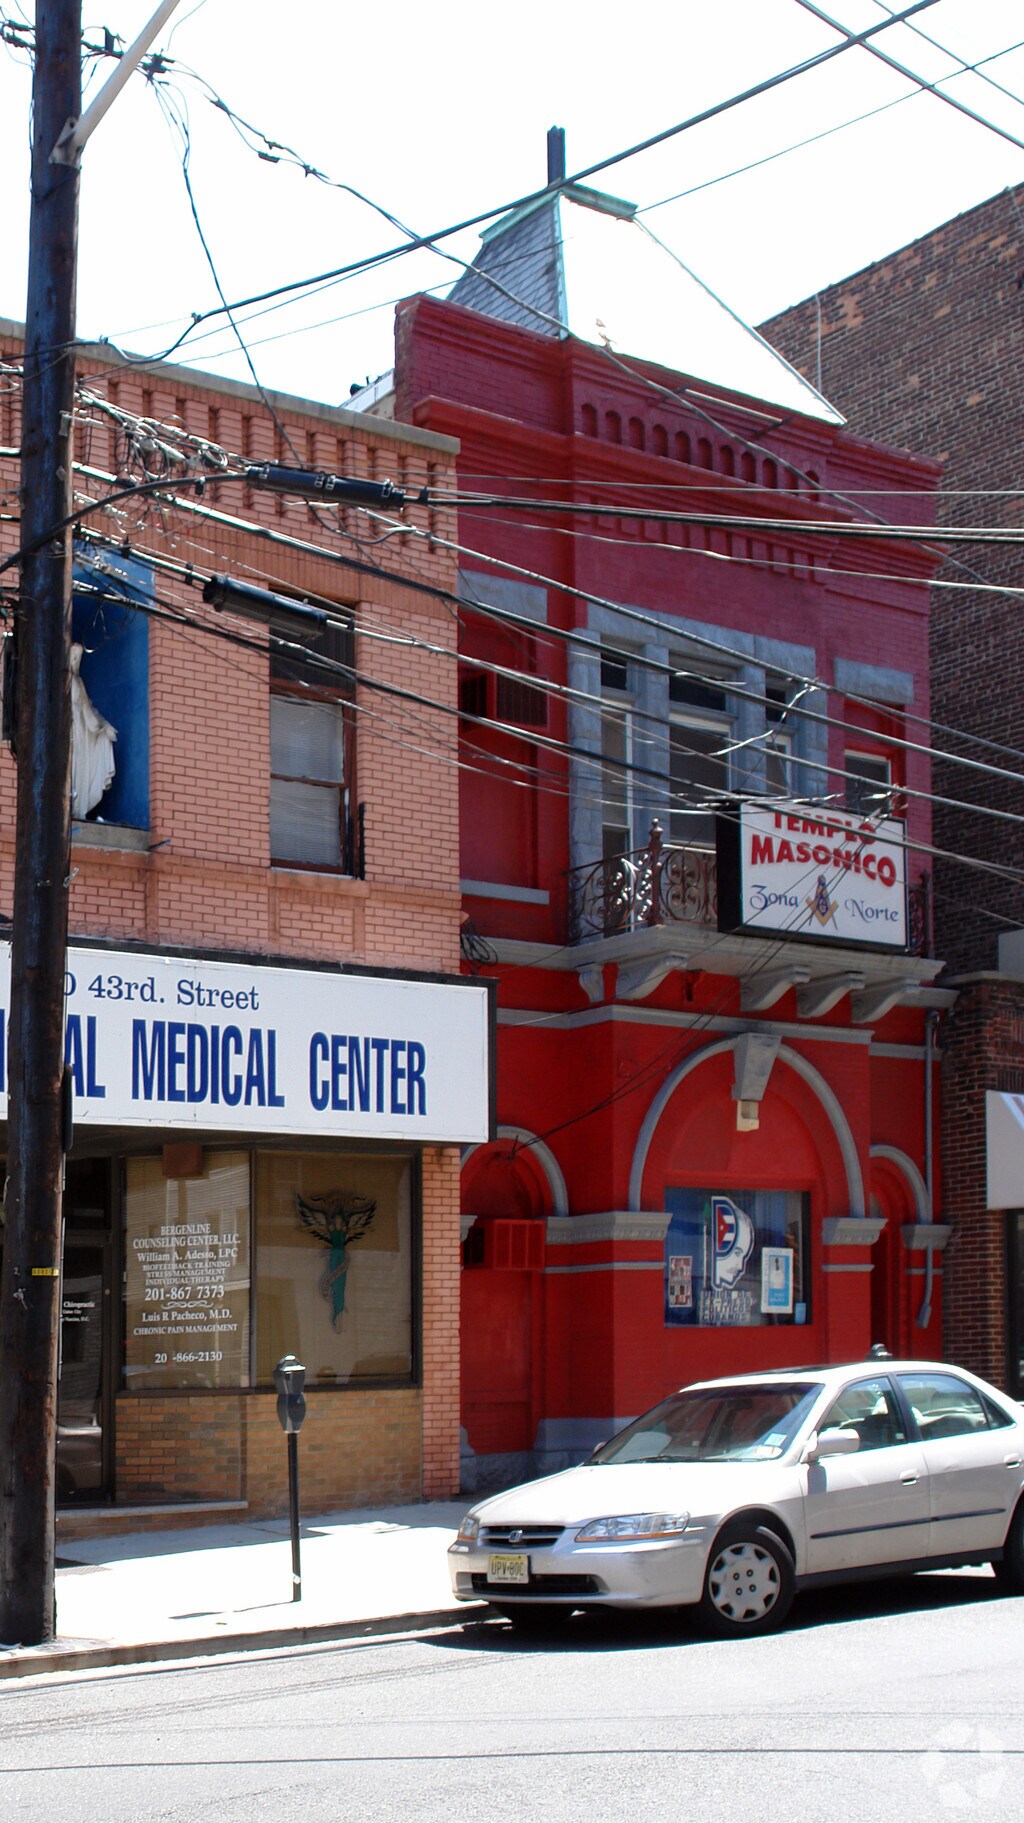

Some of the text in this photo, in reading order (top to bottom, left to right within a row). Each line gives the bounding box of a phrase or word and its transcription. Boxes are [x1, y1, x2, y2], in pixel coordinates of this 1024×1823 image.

[751, 834, 897, 888] MASONICO
[750, 884, 899, 923] Zona Norte
[88, 975, 165, 1003] 43rd.
[177, 979, 260, 1010] Street
[132, 1018, 285, 1108] MEDICAL
[310, 1031, 427, 1116] CENTER
[160, 1223, 211, 1235] BERGENLINE
[133, 1236, 186, 1249] COUNSELING
[137, 1251, 170, 1262] William
[173, 1250, 183, 1260] A.
[218, 1247, 238, 1258] LPC
[194, 1260, 231, 1268] TRAINING
[173, 1268, 226, 1277] MANAGEMENT
[190, 1275, 225, 1283] THERAPY
[196, 1285, 225, 1299] 7373
[142, 1312, 160, 1322] Luis
[171, 1310, 207, 1321] Pacheco,
[209, 1308, 232, 1319] M.D.
[133, 1324, 238, 1335] CHRONIC PAIN MANAGEMENT
